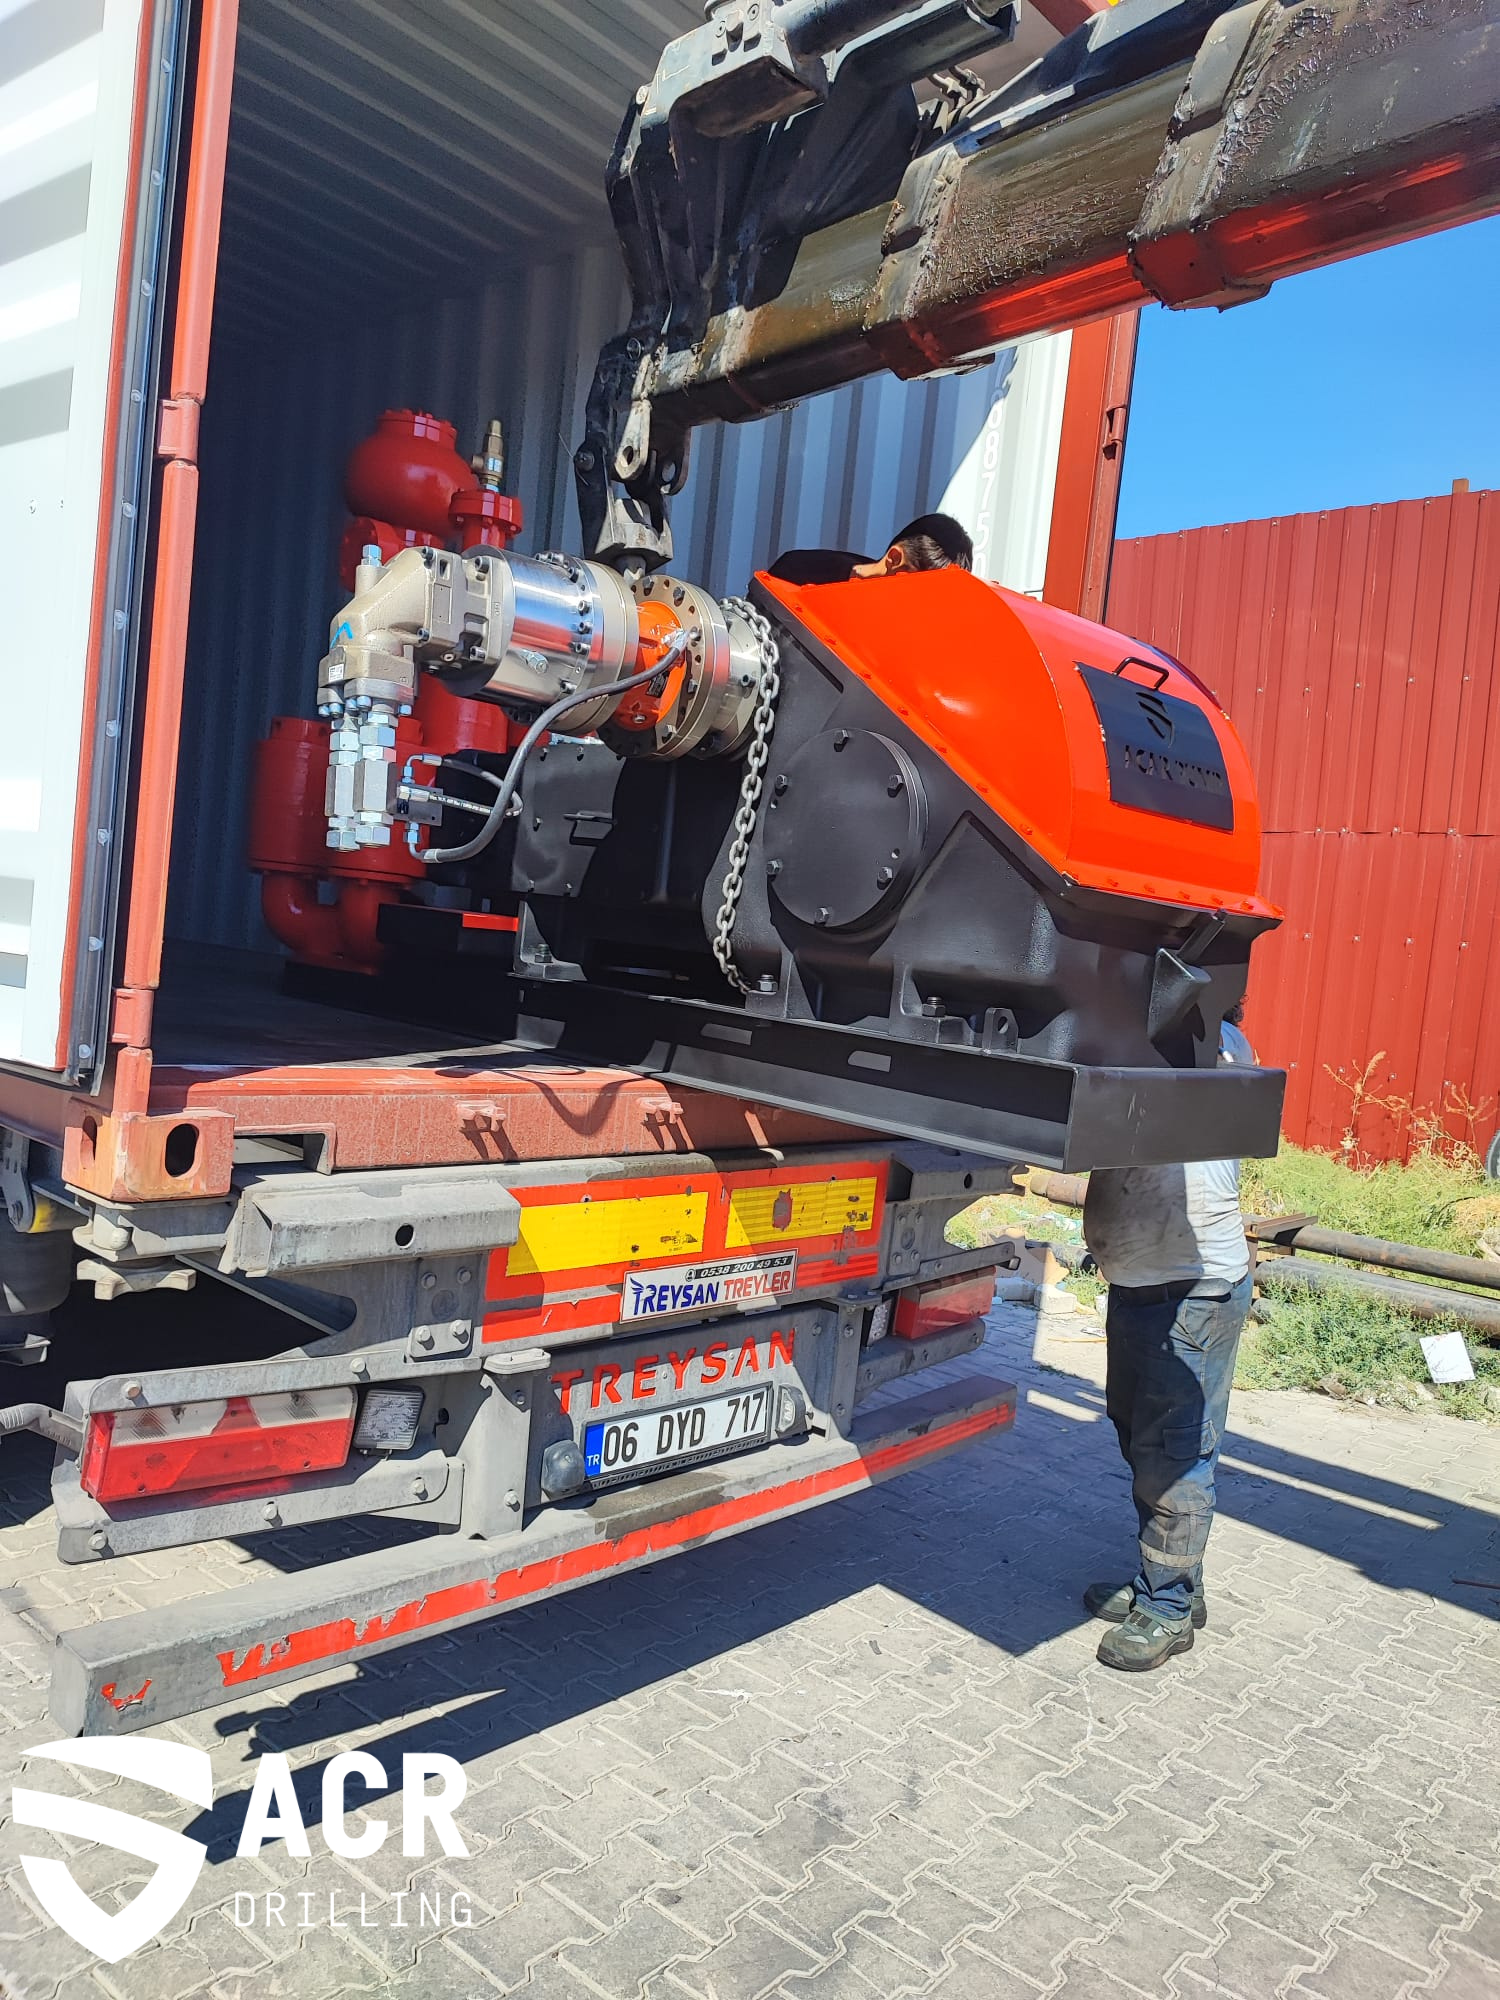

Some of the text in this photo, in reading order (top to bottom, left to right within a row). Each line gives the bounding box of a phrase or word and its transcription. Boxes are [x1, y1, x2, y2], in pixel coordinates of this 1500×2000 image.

[630, 1270, 791, 1316] TREYSAN TREYLER
[700, 1257, 788, 1278] 0538 200 49 53
[551, 1328, 796, 1415] TREYSAN
[587, 1391, 765, 1467] TR 06 DYD 717
